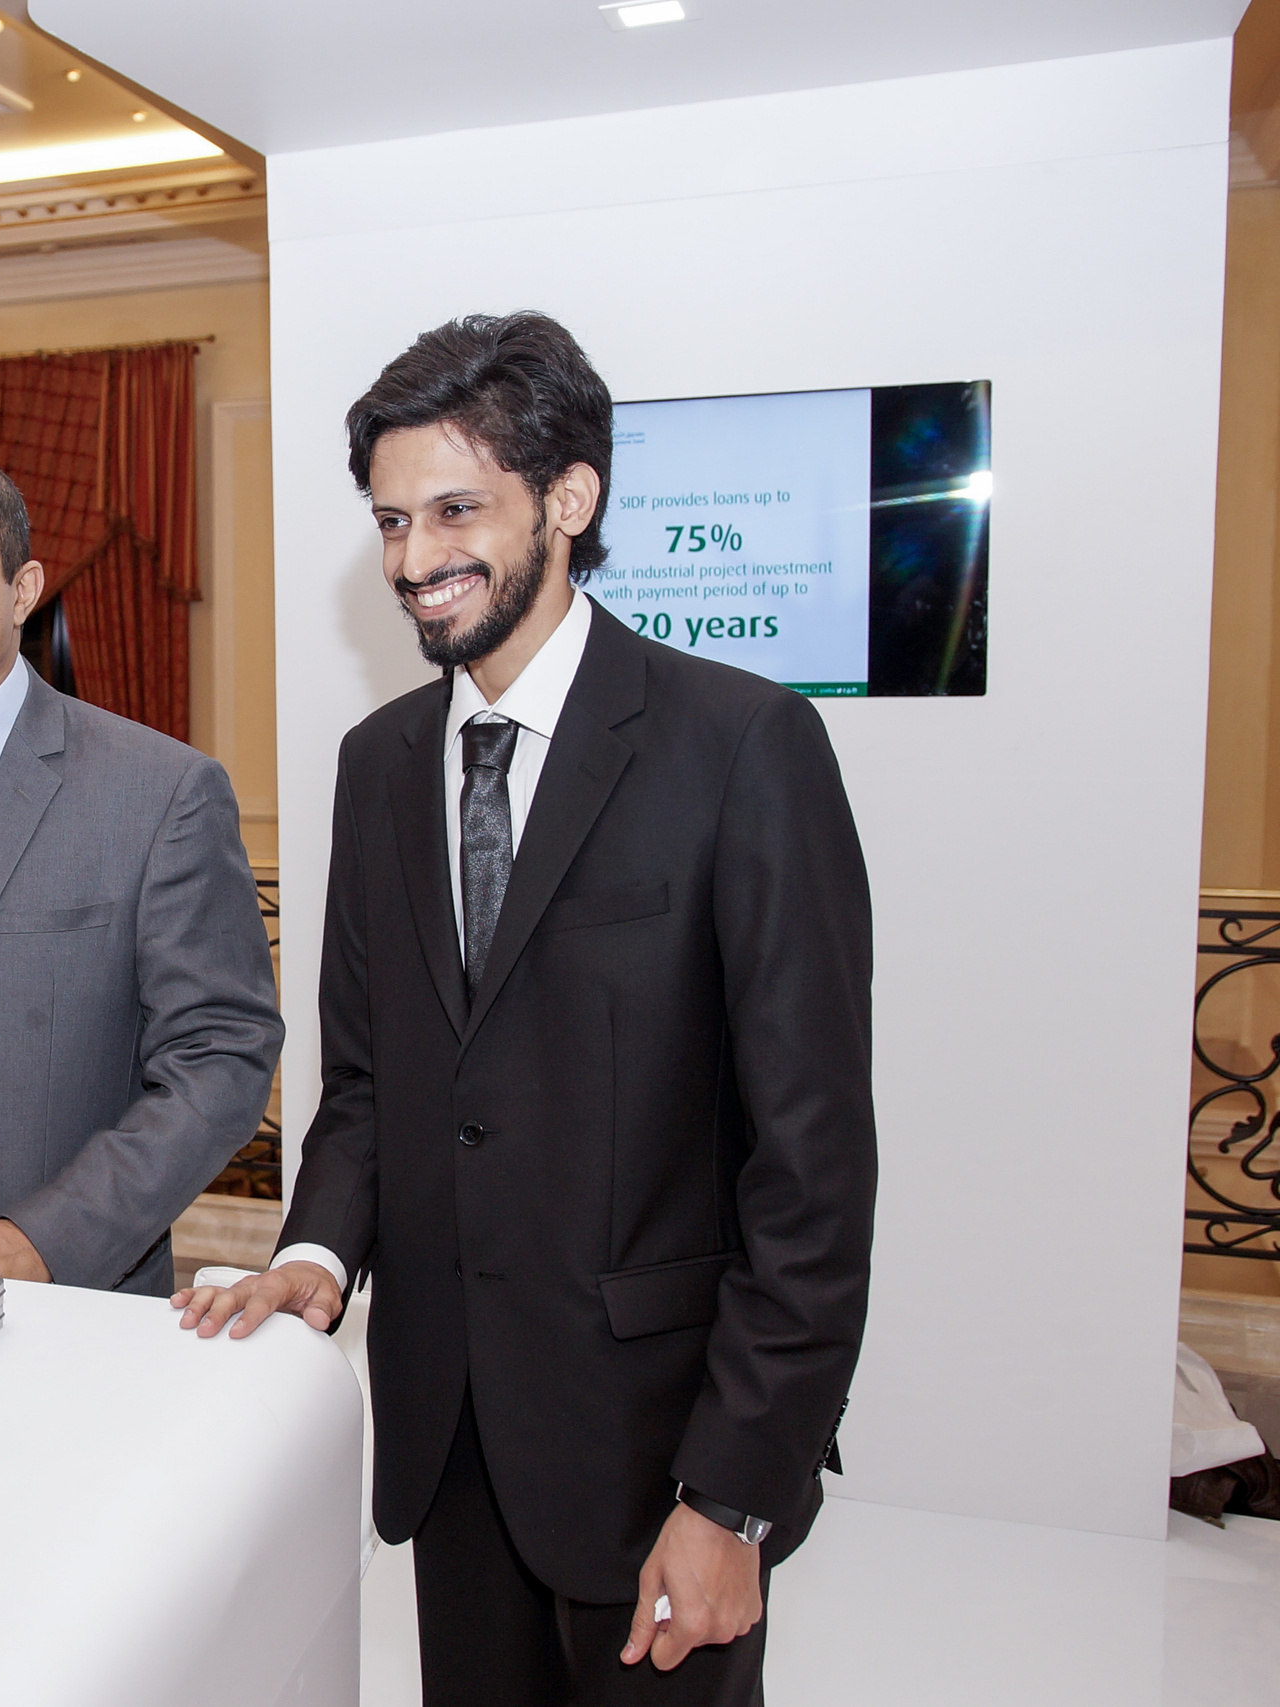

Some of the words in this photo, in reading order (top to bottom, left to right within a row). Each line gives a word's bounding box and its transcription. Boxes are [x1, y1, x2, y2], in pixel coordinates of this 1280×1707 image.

[620, 495, 646, 509] SIDF
[652, 492, 709, 510] provides
[713, 491, 750, 505] loans
[754, 492, 772, 506] up
[777, 490, 790, 503] to
[665, 524, 743, 553] 75%
[599, 568, 627, 583] your
[632, 564, 695, 579] industrial
[700, 562, 747, 580] project
[752, 560, 833, 576] investment
[603, 585, 633, 599] with
[638, 585, 698, 602] payment
[704, 581, 748, 600] period
[752, 580, 767, 595] of
[771, 583, 789, 598] up
[795, 582, 808, 595] to
[631, 612, 672, 640] 20
[685, 615, 779, 647] years
